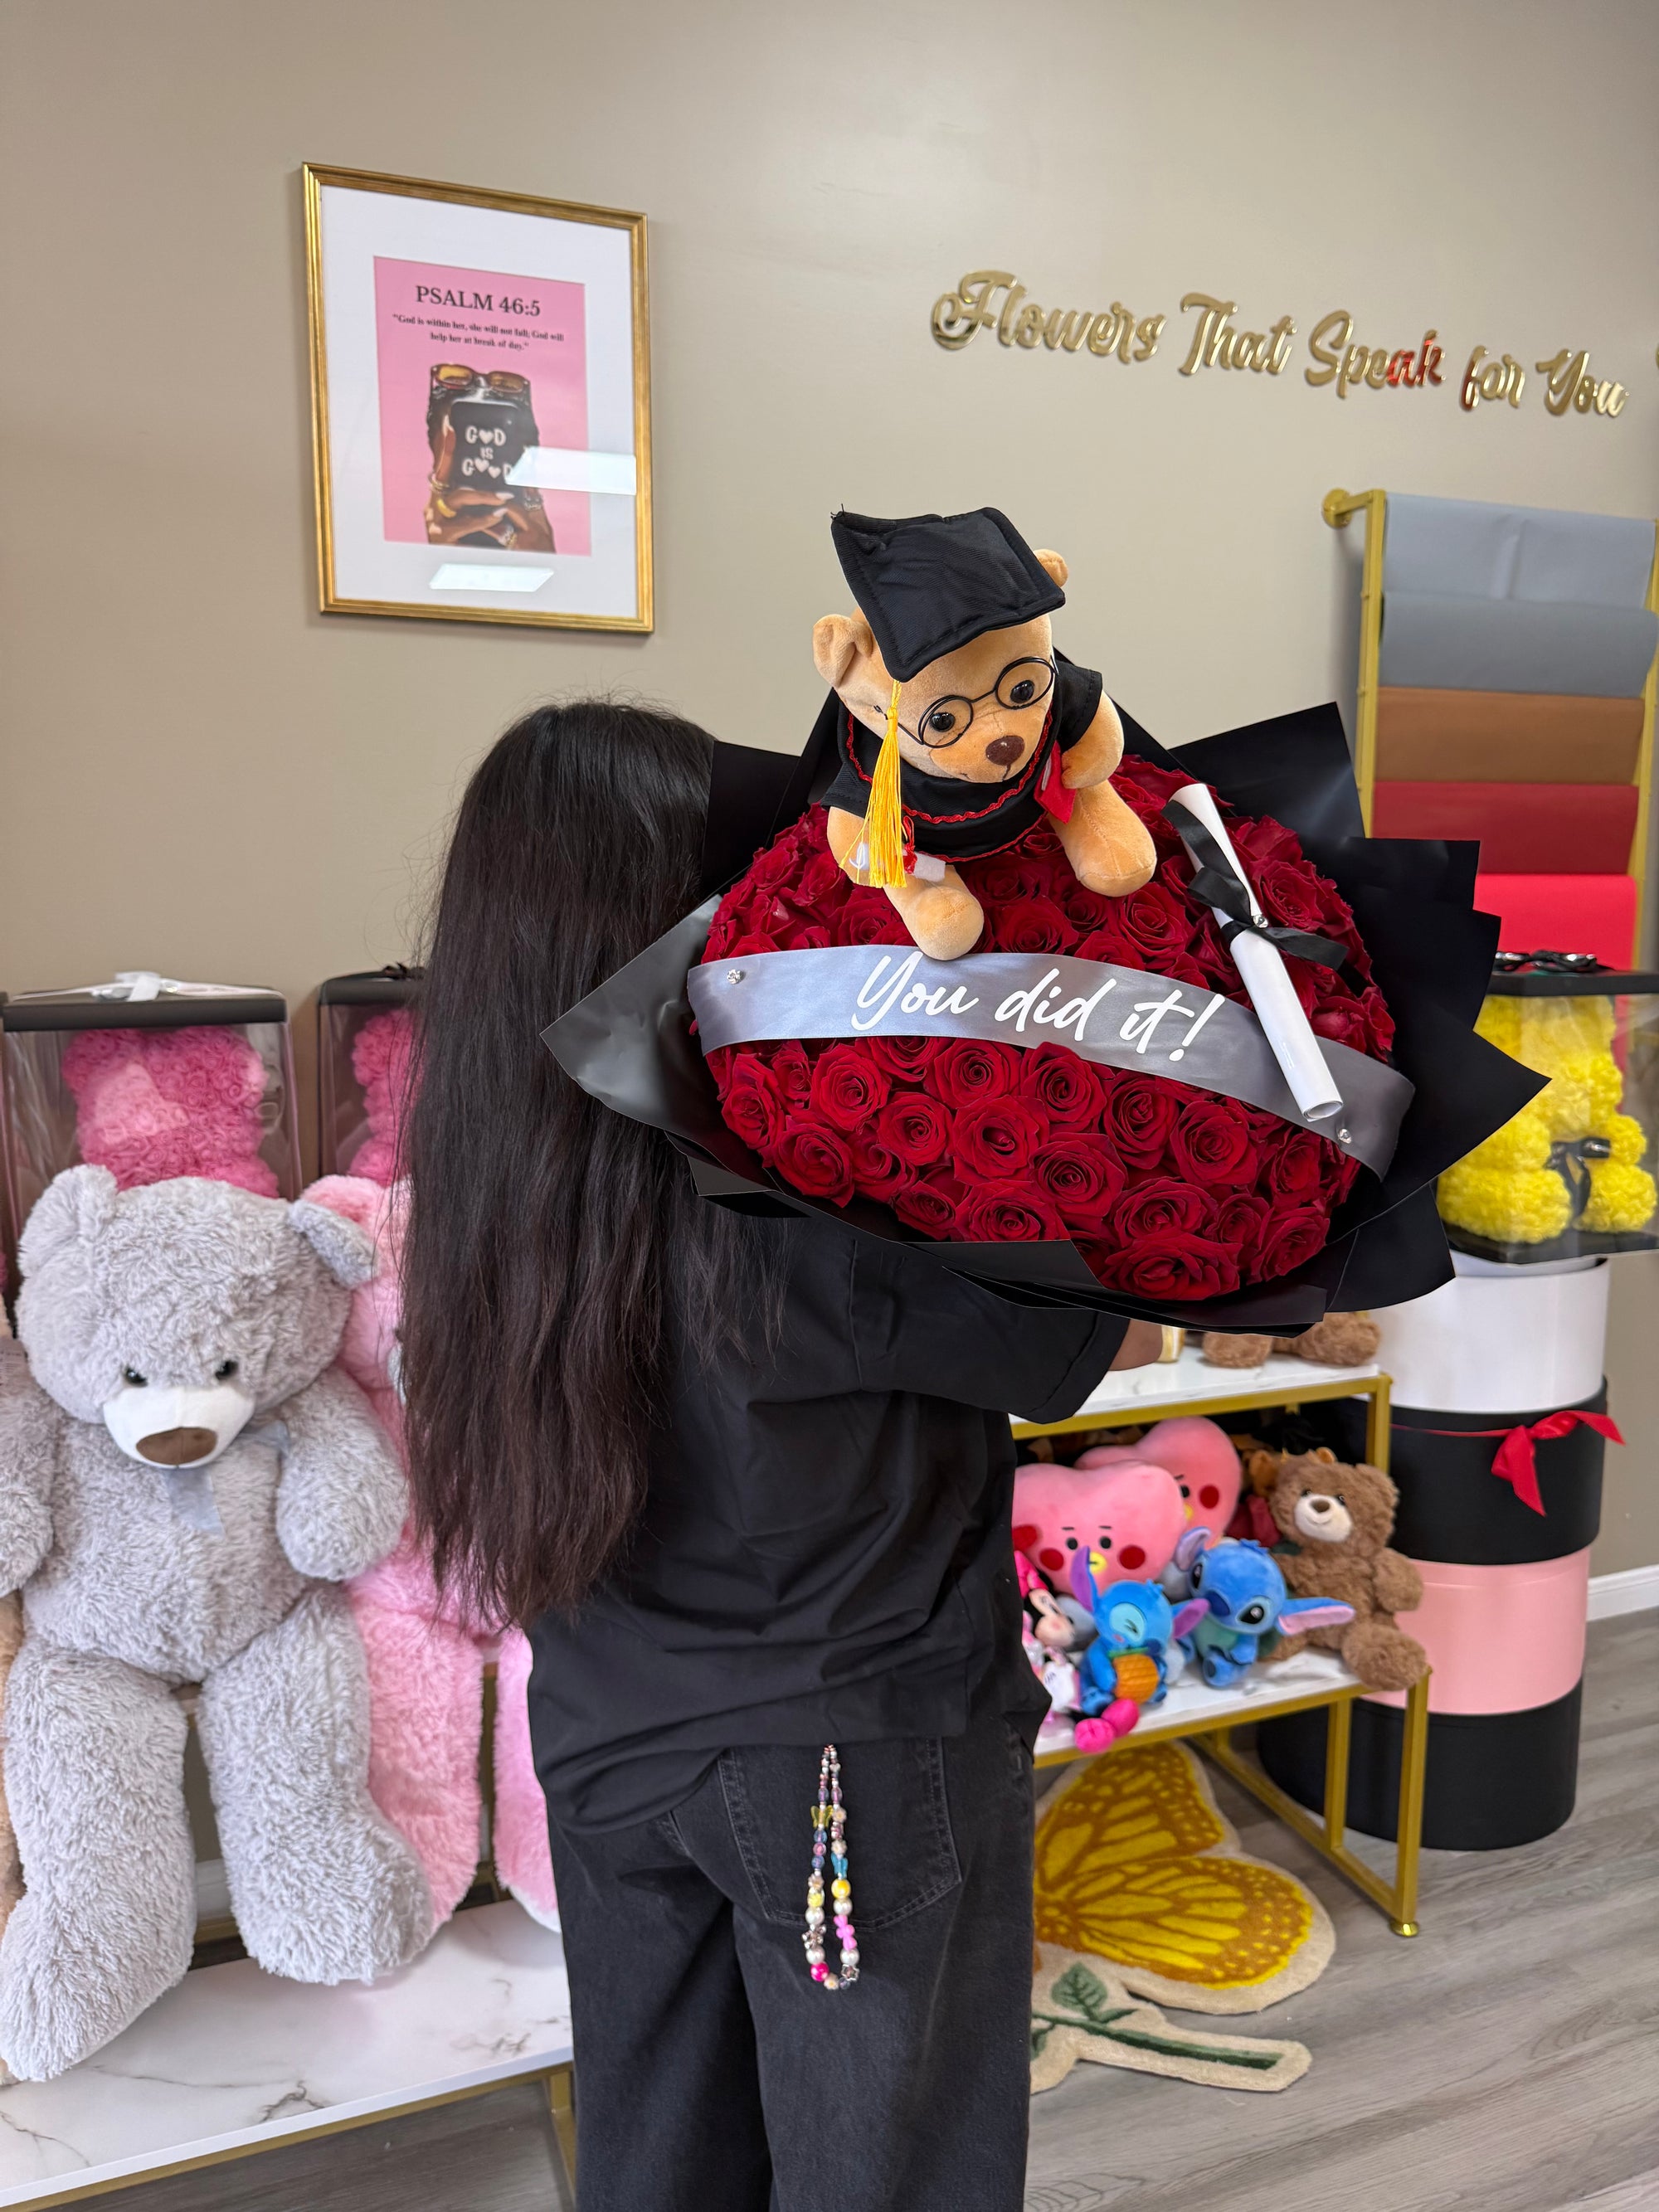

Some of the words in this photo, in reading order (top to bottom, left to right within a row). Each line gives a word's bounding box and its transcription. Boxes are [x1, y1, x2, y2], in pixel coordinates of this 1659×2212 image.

[416, 285, 494, 311] PSALM
[499, 296, 541, 317] 46:5
[426, 318, 451, 328] within
[469, 323, 481, 332] she
[484, 325, 499, 333] will
[500, 328, 513, 336] not
[532, 330, 548, 340] God
[550, 333, 564, 342] will
[430, 332, 448, 343] help
[449, 334, 462, 343] her
[474, 337, 496, 347] break
[931, 270, 1167, 365] Flowers
[1178, 292, 1297, 376] That
[1304, 309, 1446, 399] Speak
[1459, 344, 1525, 411] for
[1535, 348, 1631, 417] You
[479, 446, 494, 459] IS
[850, 950, 980, 1031] You
[995, 968, 1117, 1042] did
[1118, 989, 1225, 1062] it!
